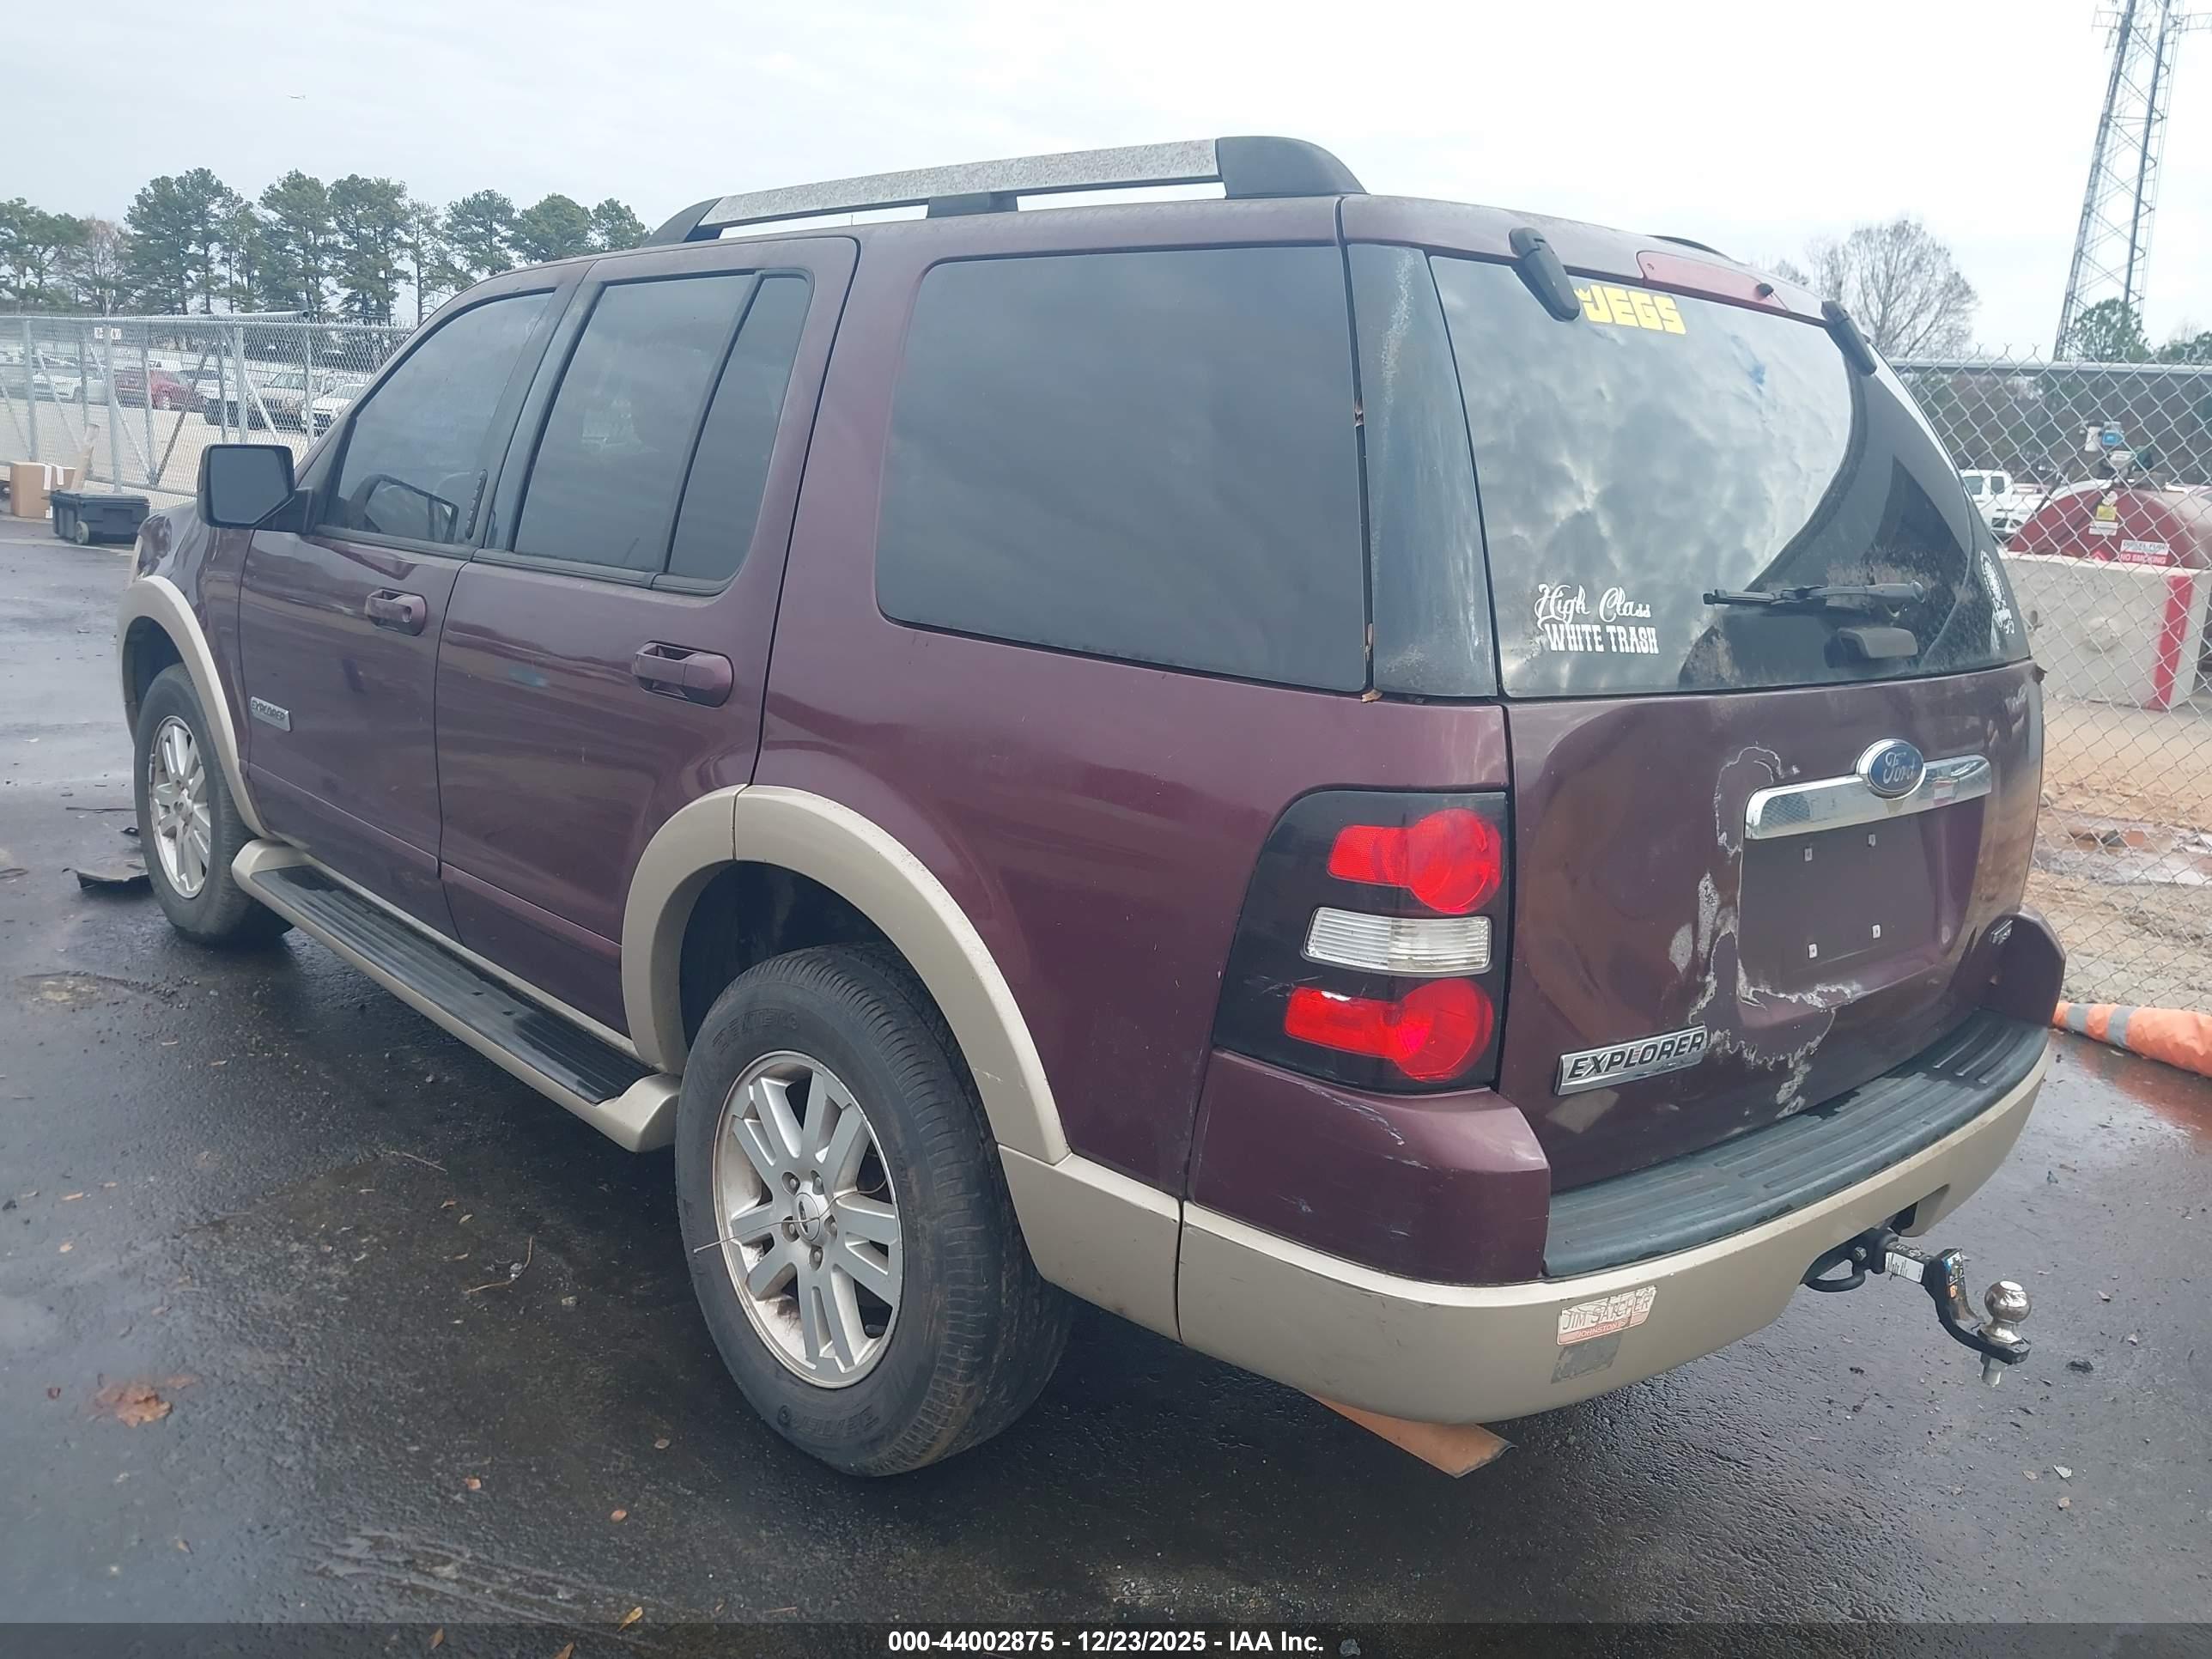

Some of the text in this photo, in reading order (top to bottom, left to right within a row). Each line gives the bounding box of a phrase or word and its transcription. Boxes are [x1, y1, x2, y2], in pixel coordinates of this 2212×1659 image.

[1582, 284, 1686, 335] JEGS
[1534, 583, 1652, 631] High Class
[1544, 623, 1660, 654] WHITE TRASH
[1882, 751, 1917, 785] Ford
[1566, 1032, 1706, 1079] EXPLORER
